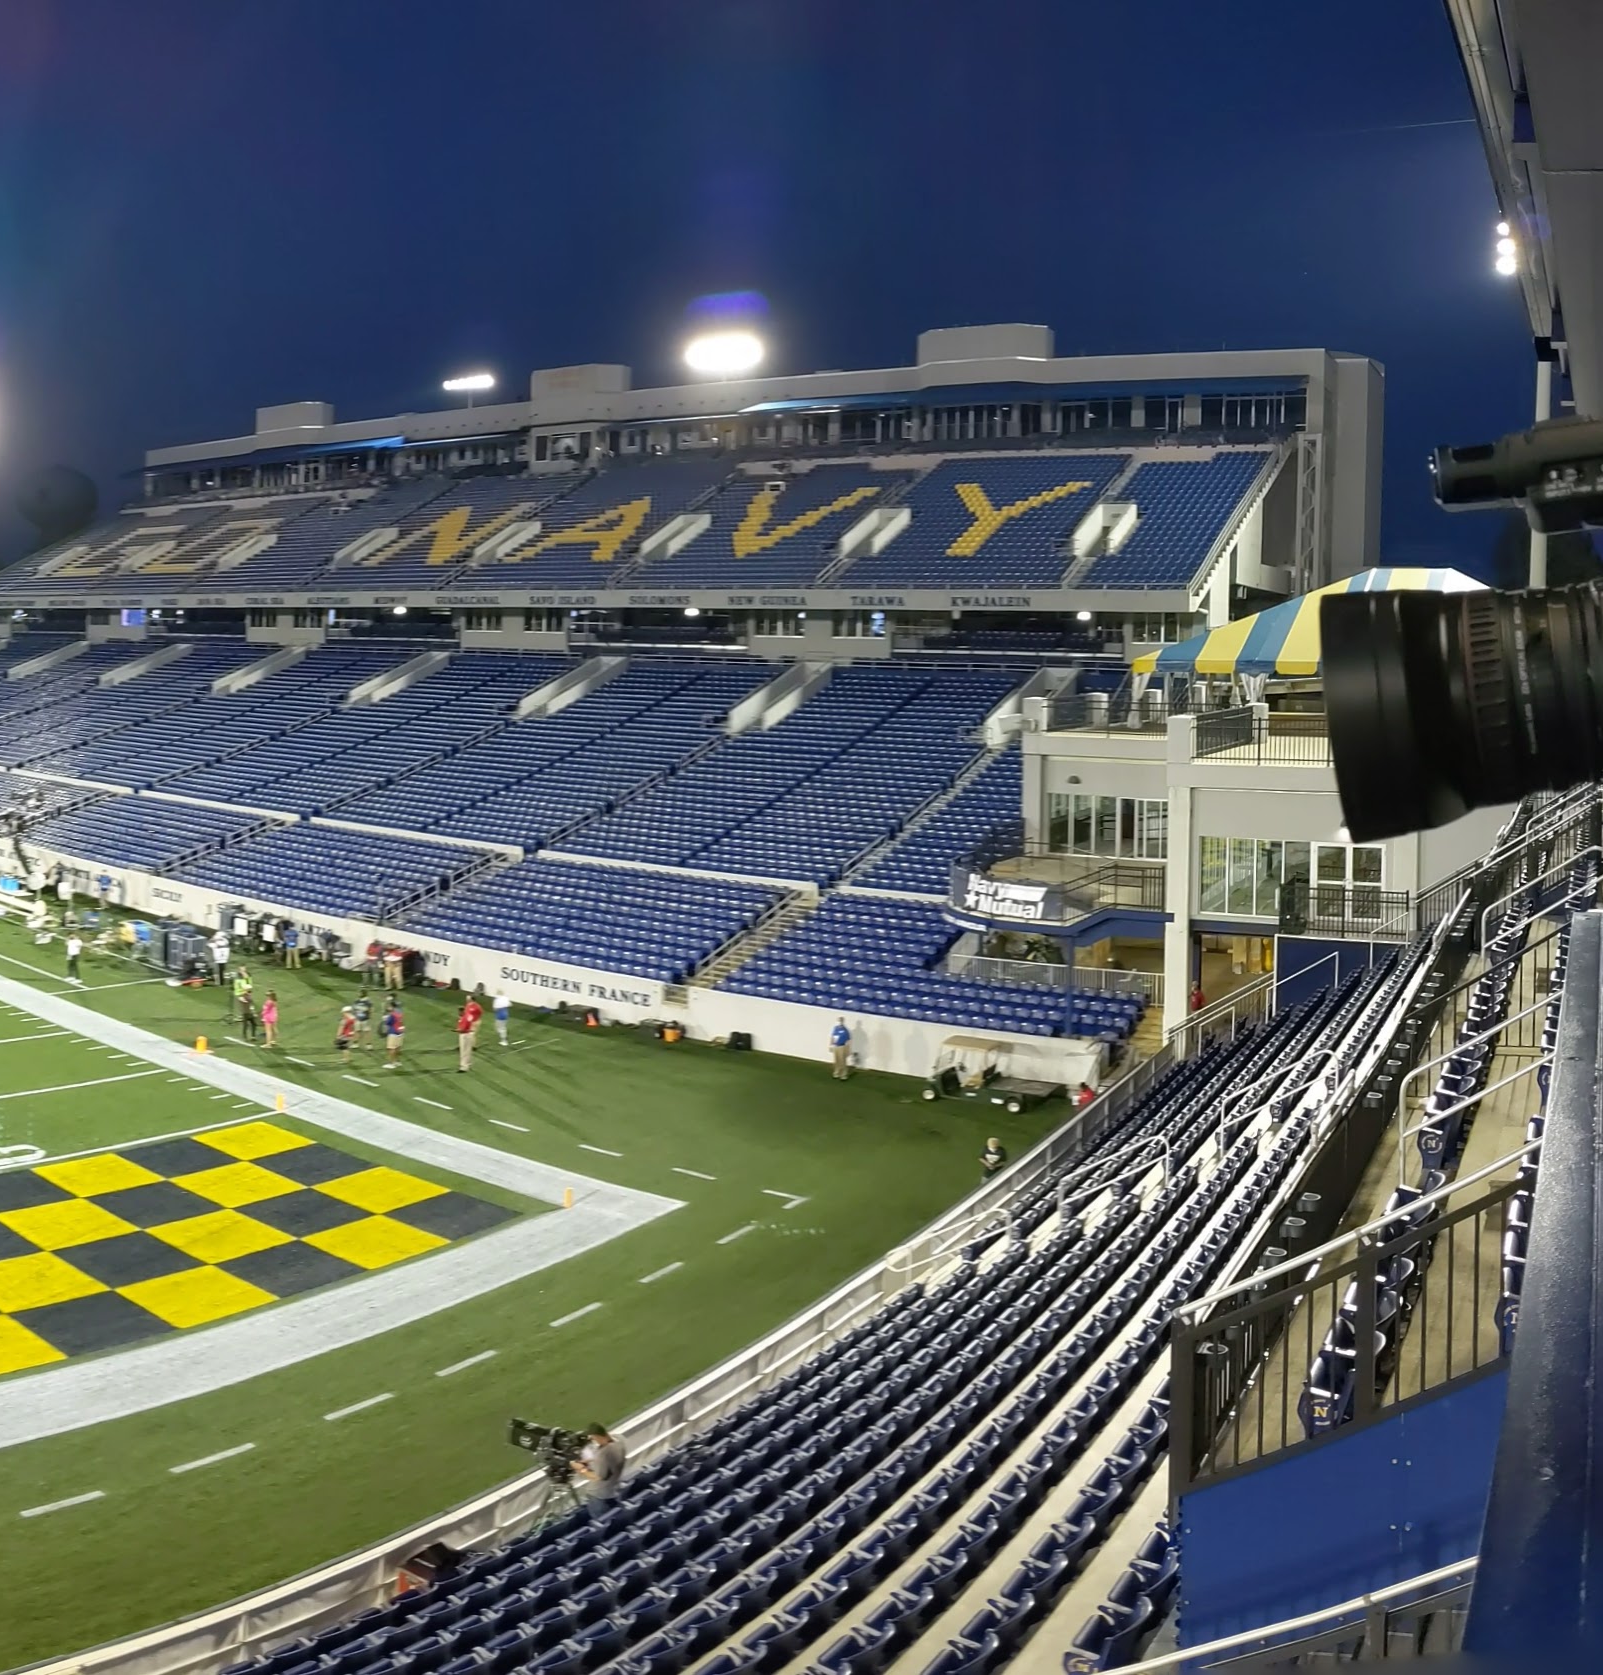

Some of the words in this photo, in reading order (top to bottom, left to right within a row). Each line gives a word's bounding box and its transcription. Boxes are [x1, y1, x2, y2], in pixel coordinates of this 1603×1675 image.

[362, 481, 1093, 567] NAVY
[850, 596, 906, 607] TARAWA
[950, 596, 1032, 607] KWAJALEIN
[967, 872, 1005, 900] Navy
[977, 893, 1045, 919] Mutual
[500, 966, 583, 994] SOUTHERN
[588, 983, 652, 1007] FRANCE
